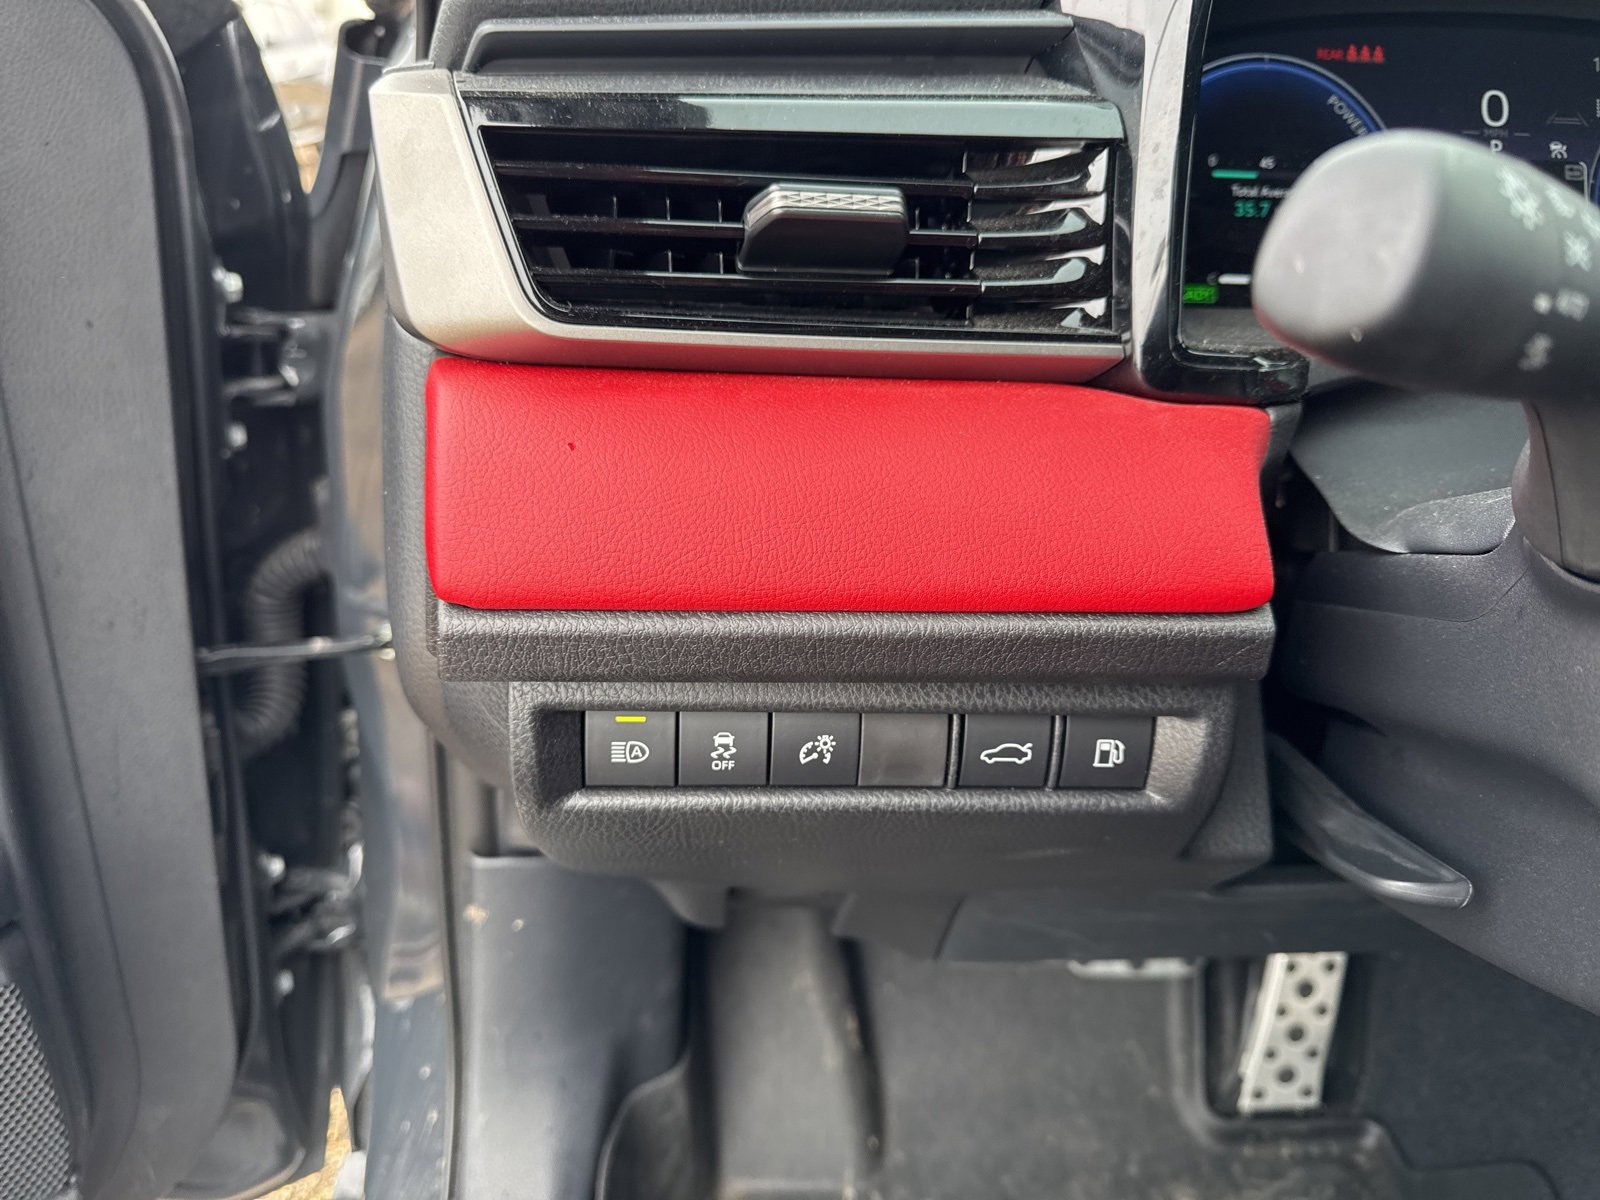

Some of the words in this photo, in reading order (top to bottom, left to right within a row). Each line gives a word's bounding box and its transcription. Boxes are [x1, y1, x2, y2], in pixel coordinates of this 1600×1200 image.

[1481, 89, 1509, 127] 0
[1231, 183, 1259, 198] Total
[1233, 200, 1272, 218] 35.7
[711, 760, 735, 771] OFF
